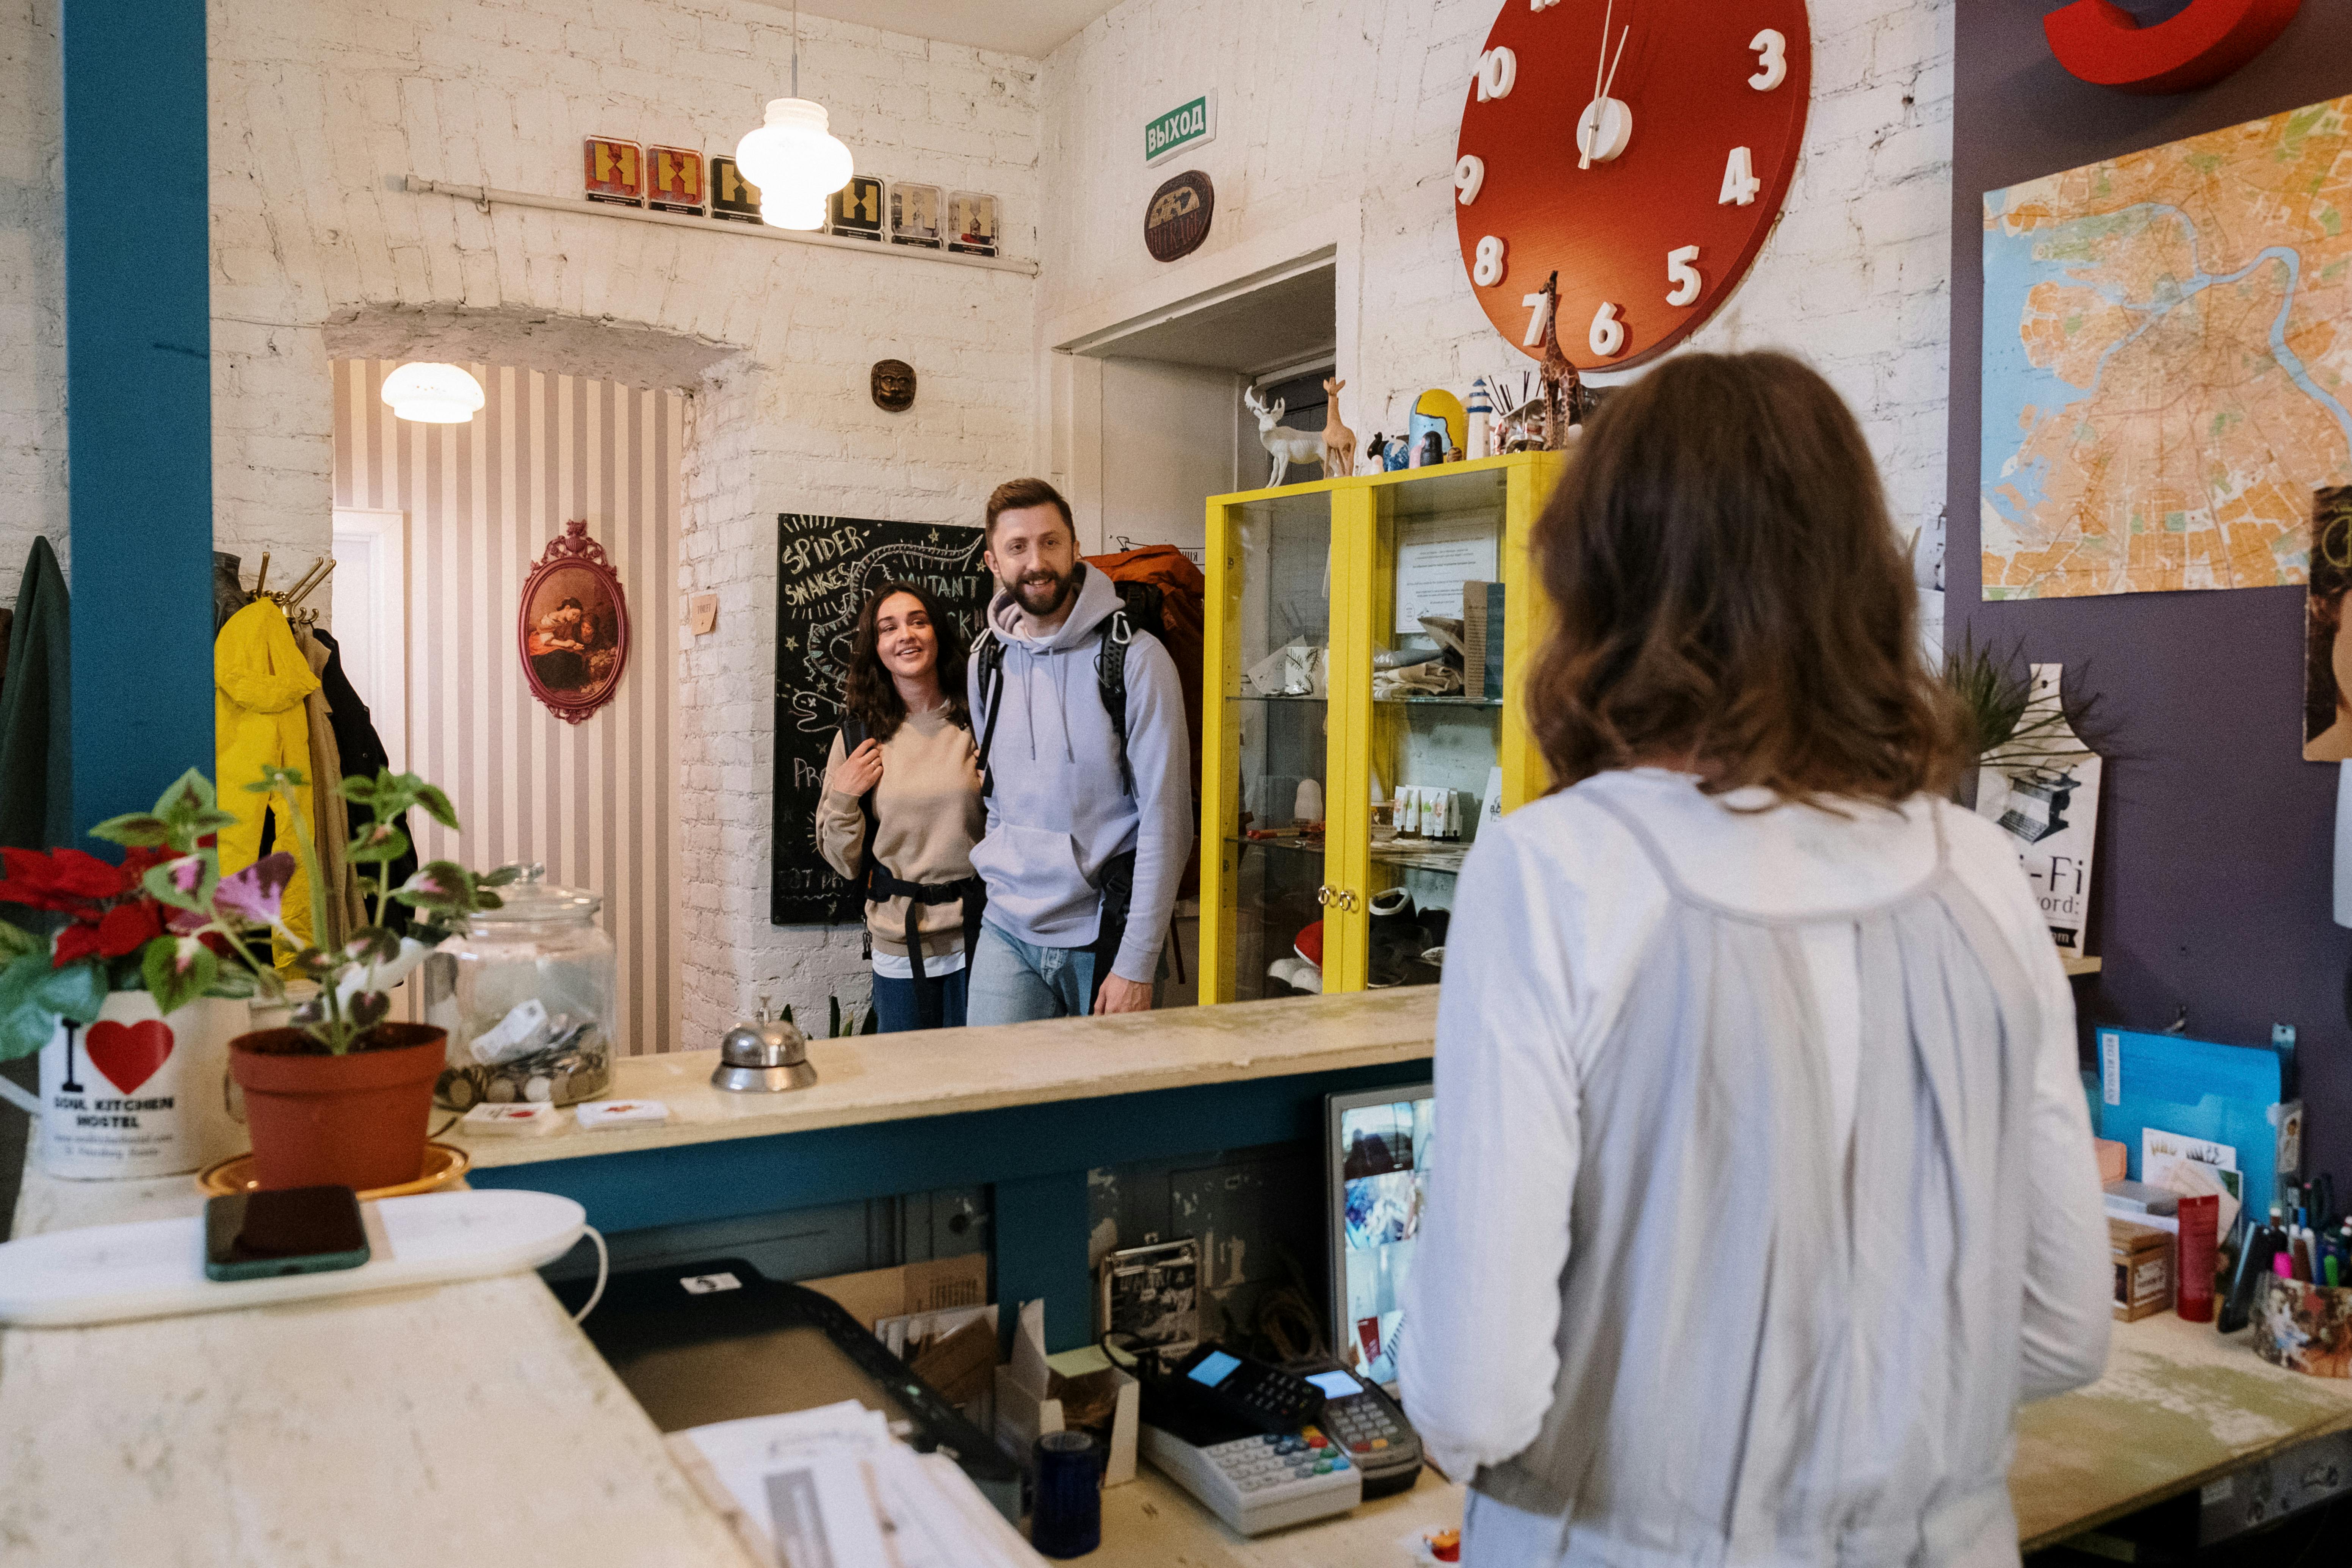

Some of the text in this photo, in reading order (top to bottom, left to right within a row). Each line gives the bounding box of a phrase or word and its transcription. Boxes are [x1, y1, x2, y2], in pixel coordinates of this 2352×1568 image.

[1469, 46, 1516, 103] 10
[1748, 29, 1786, 91] 3
[1148, 105, 1203, 153] ВЫХОД
[1454, 155, 1484, 205] 9
[1719, 146, 1760, 205] 4
[1474, 235, 1504, 287] 8
[1666, 245, 1701, 306] 5
[1522, 292, 1548, 346] 7
[1589, 302, 1624, 356] 6
[697, 603, 711, 614] TOILET
[785, 563, 850, 606] SNAKES
[62, 1018, 83, 1092] I
